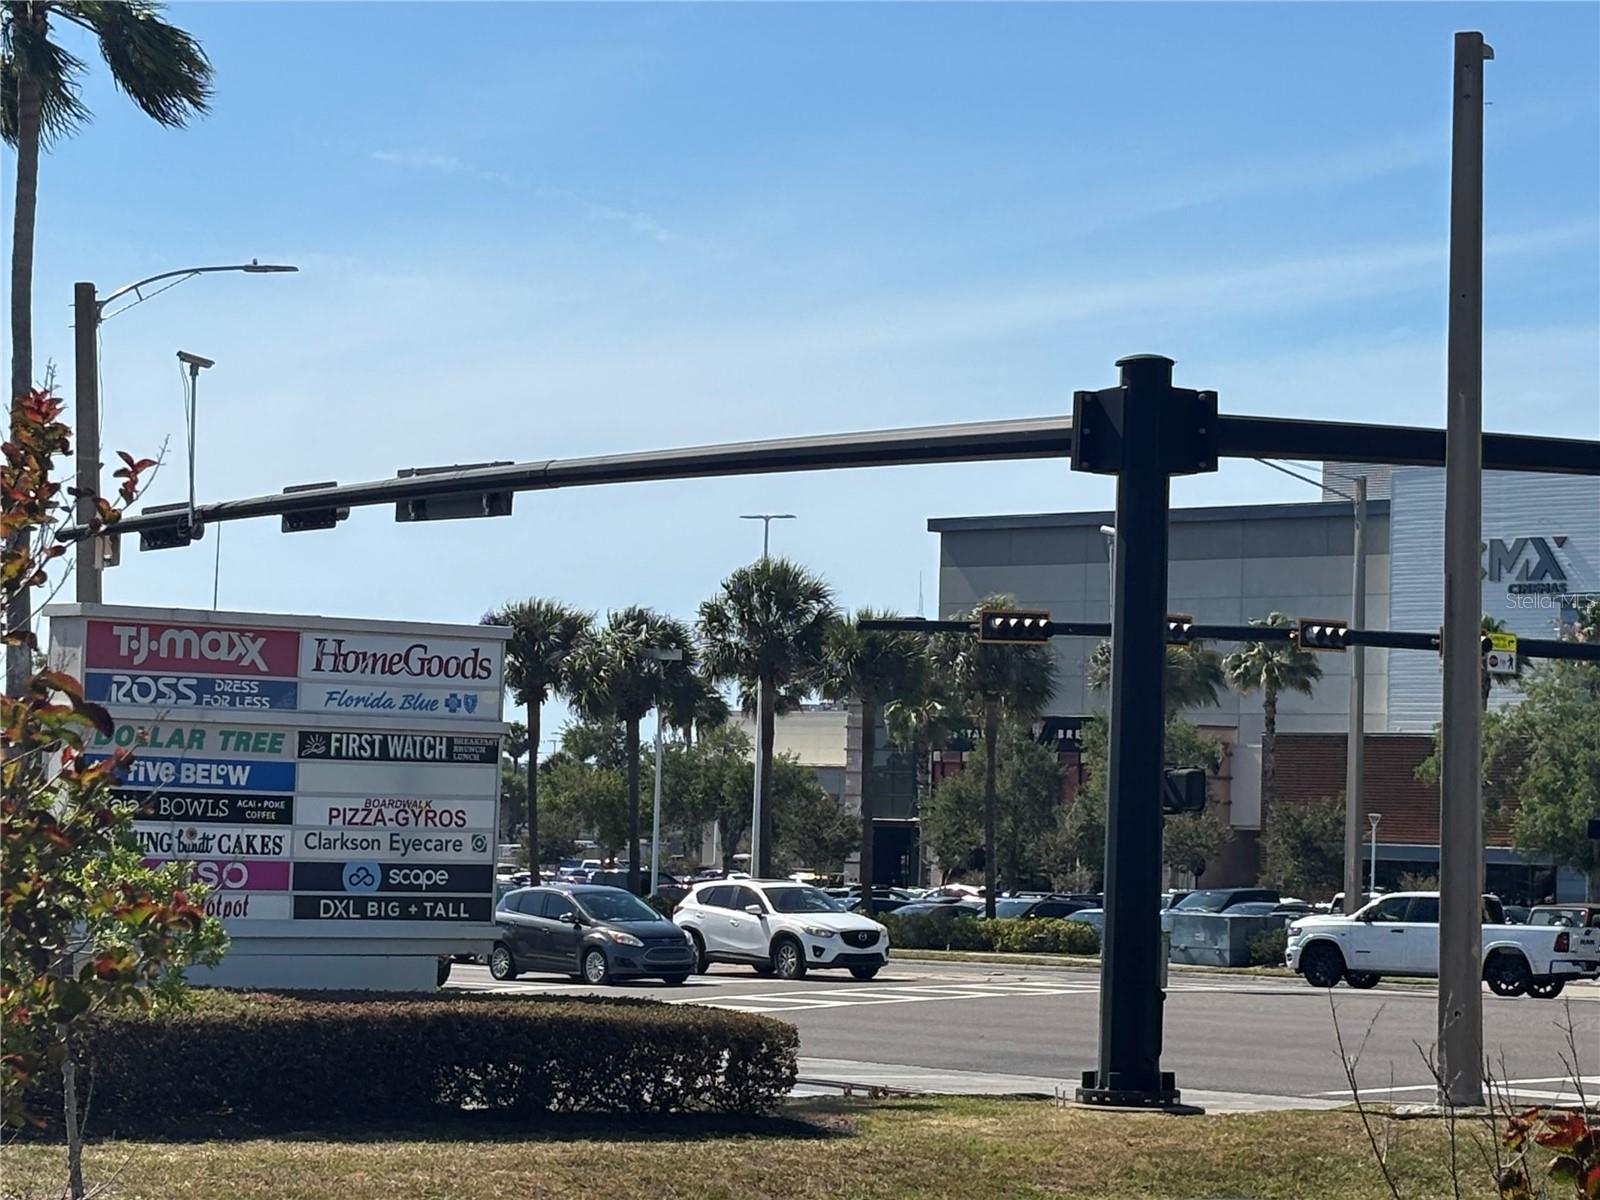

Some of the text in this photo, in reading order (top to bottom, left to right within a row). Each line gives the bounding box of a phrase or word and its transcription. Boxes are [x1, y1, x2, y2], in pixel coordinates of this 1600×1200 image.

[1480, 536, 1569, 582] MX
[1508, 583, 1568, 594] CINEMAS
[311, 637, 493, 680] HomeGoods
[110, 675, 198, 706] ROSS
[214, 679, 260, 694] DRESS
[202, 695, 271, 709] FOR LESS
[324, 689, 440, 711] Florida Blue
[218, 730, 286, 754] TREE
[330, 733, 447, 760] FIRST WATCH
[159, 797, 229, 816] BOWLS
[236, 800, 286, 809] ACAI POKE
[364, 798, 432, 809] BOARDWALK
[245, 810, 276, 820] COFFEE
[328, 807, 467, 828] PIZZA-GYROS
[217, 834, 284, 856] CAKES
[304, 832, 463, 857] Clarkson Eyecare
[201, 895, 250, 919] otpot
[320, 900, 360, 918] DXL
[367, 902, 400, 917] BIG
[424, 903, 469, 918] TALL
